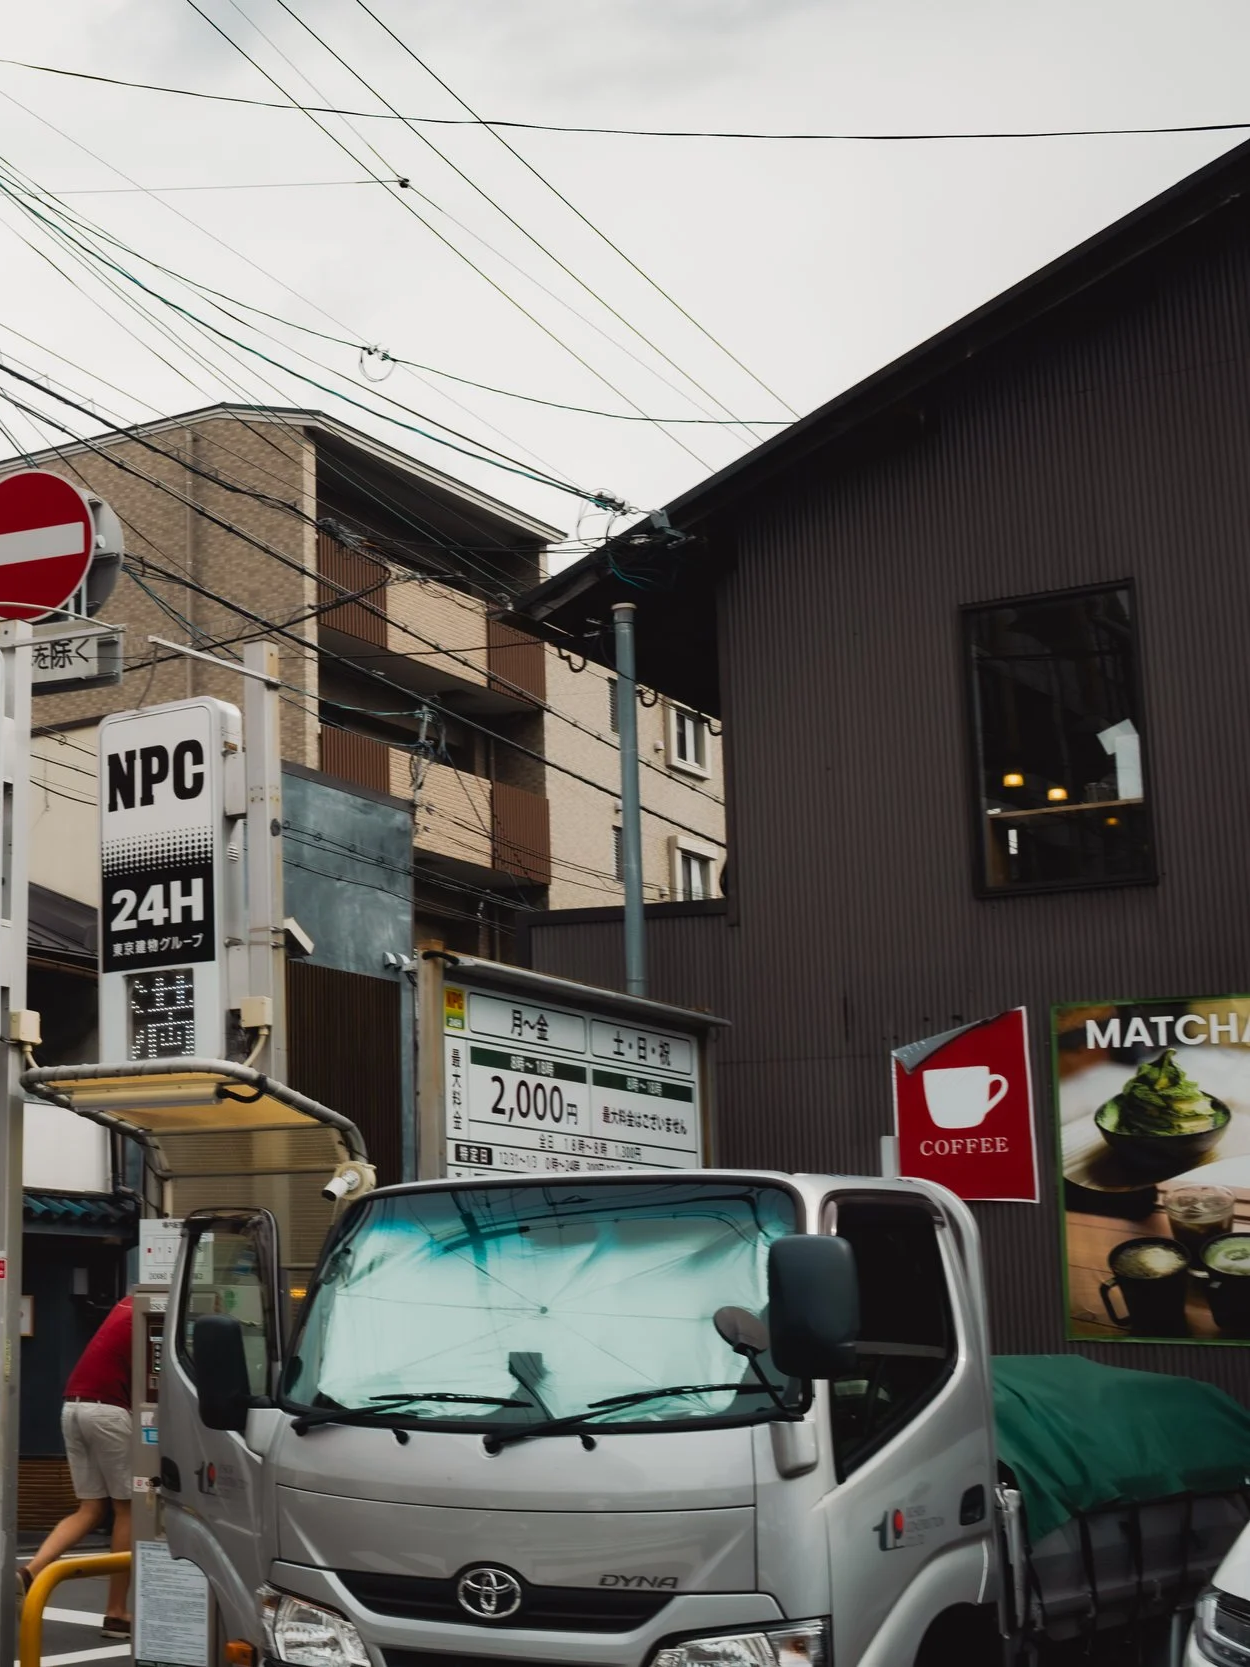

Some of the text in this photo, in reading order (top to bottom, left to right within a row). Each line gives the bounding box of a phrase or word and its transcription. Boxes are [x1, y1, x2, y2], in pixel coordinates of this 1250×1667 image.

[107, 739, 205, 813] NPC
[110, 877, 205, 932] 24H
[112, 933, 205, 958] 東京建物グループ
[130, 975, 195, 1060] 満
[490, 1075, 579, 1126] 2,000円
[919, 1136, 1009, 1157] COFFEE
[599, 1574, 680, 1589] DYNA
